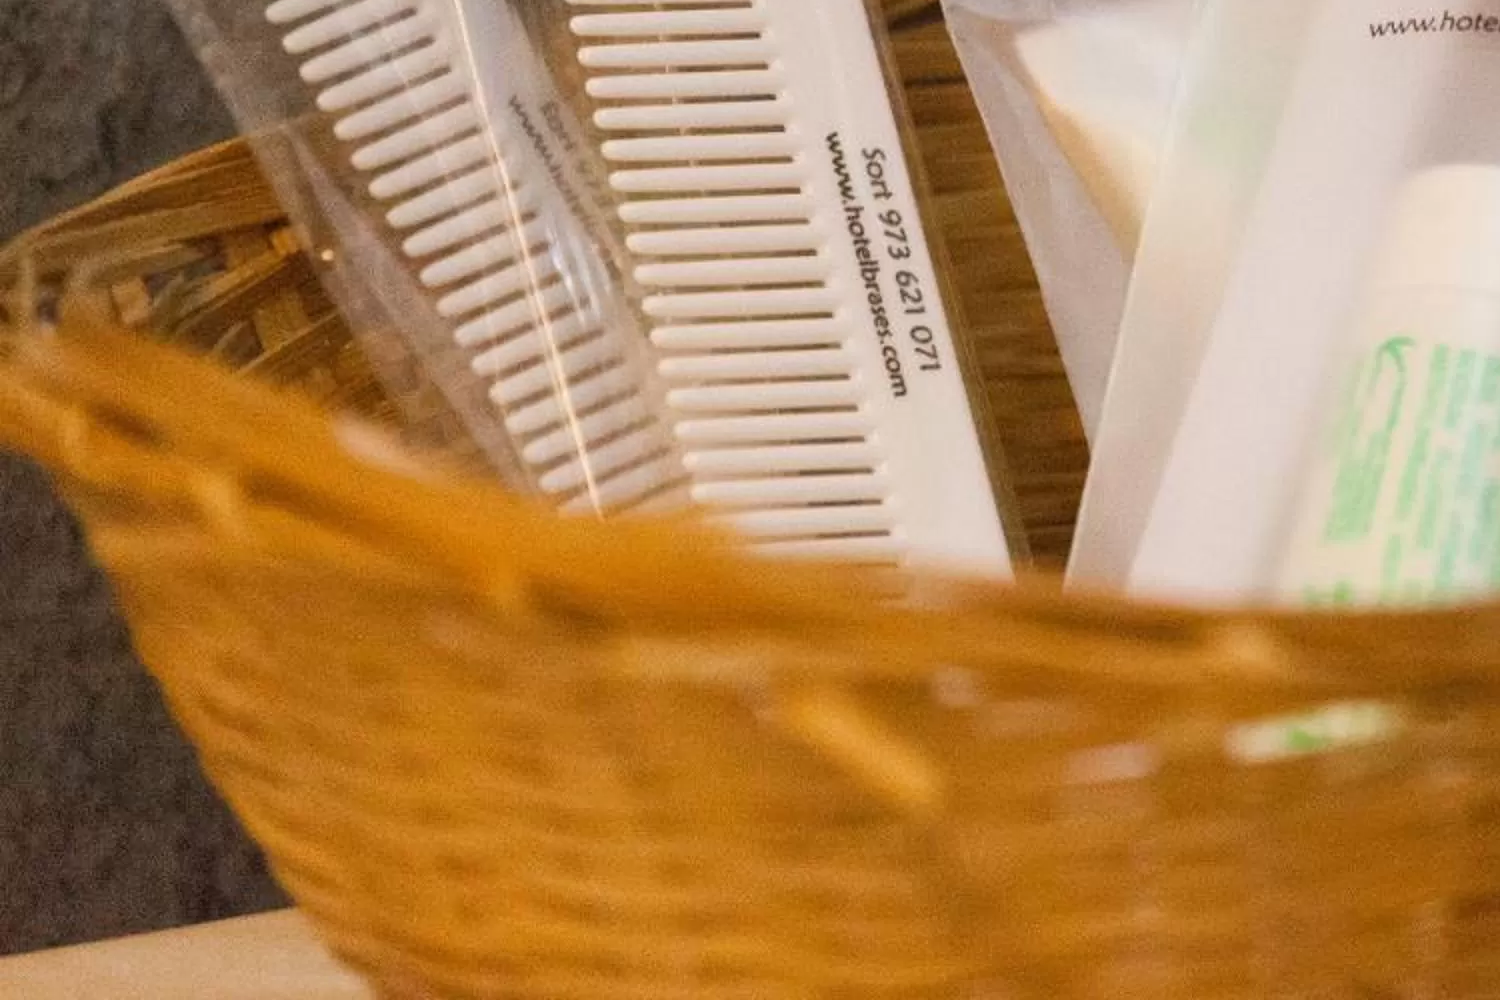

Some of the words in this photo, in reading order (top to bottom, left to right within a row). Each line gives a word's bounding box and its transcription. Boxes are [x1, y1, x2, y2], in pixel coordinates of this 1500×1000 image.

[862, 147, 893, 201] Sort
[878, 208, 911, 261] 973
[825, 131, 908, 398] www.hotelbrases.com
[895, 269, 926, 315] 621
[909, 325, 943, 373] 071
